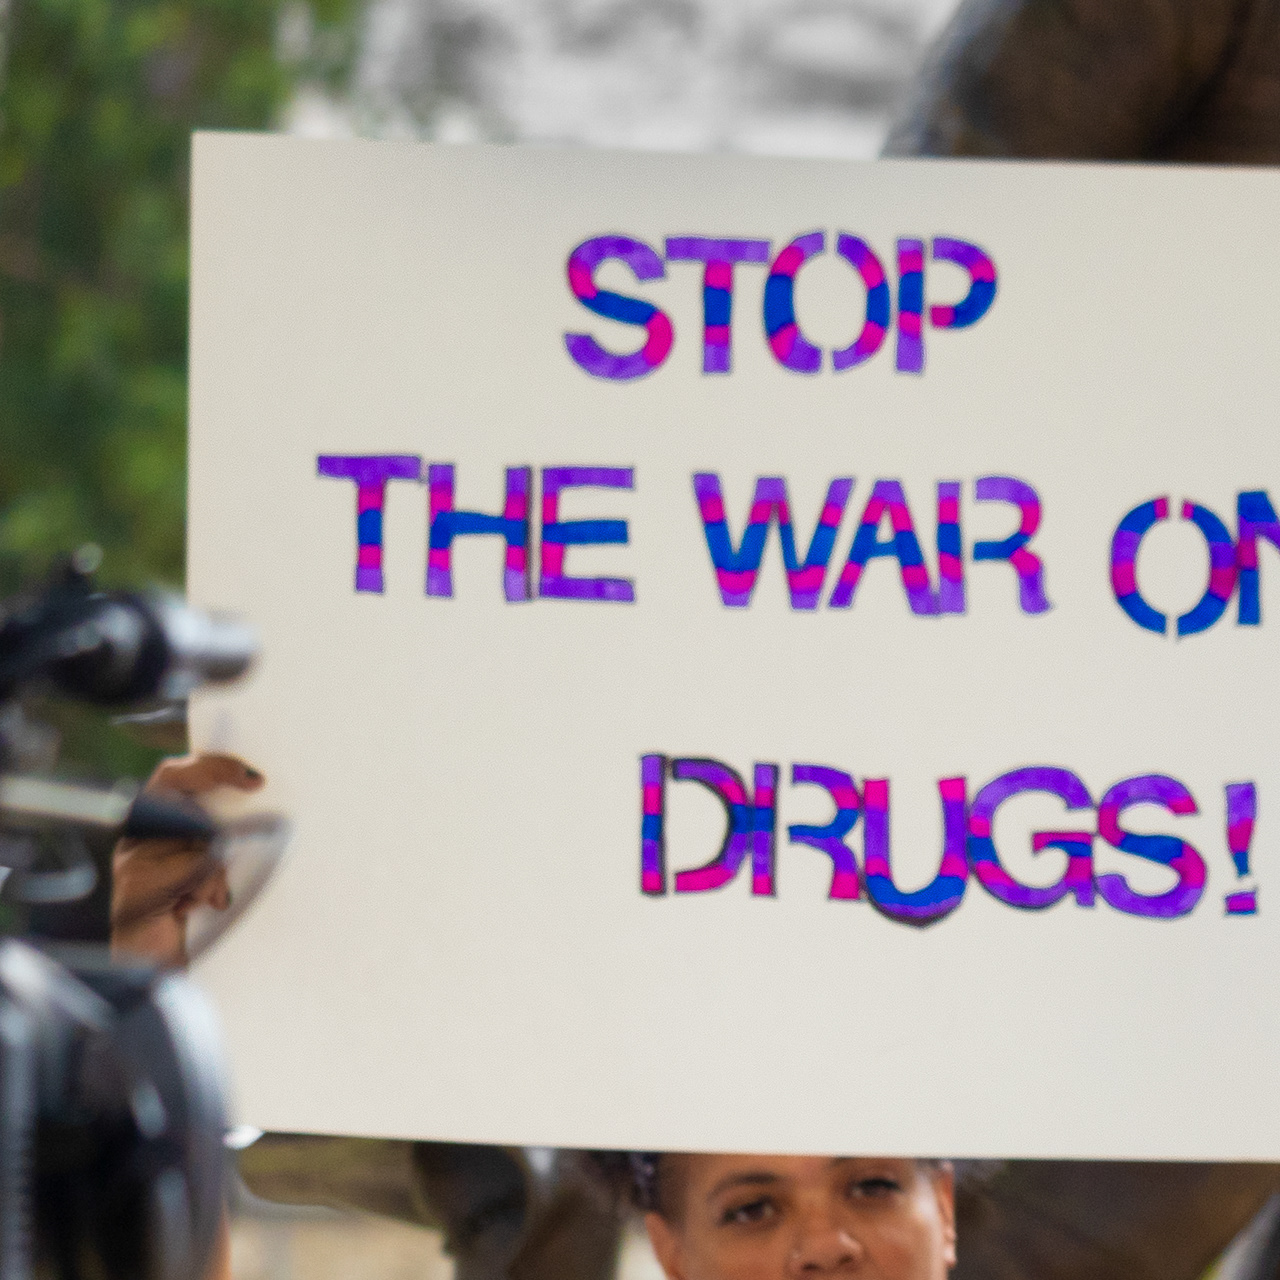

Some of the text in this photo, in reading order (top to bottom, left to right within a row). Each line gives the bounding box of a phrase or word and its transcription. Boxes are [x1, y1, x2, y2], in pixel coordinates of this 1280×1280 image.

[562, 229, 998, 382] STOP
[316, 453, 636, 604] THE
[692, 472, 1054, 616] WAR
[638, 752, 1259, 929] DRUGS!
